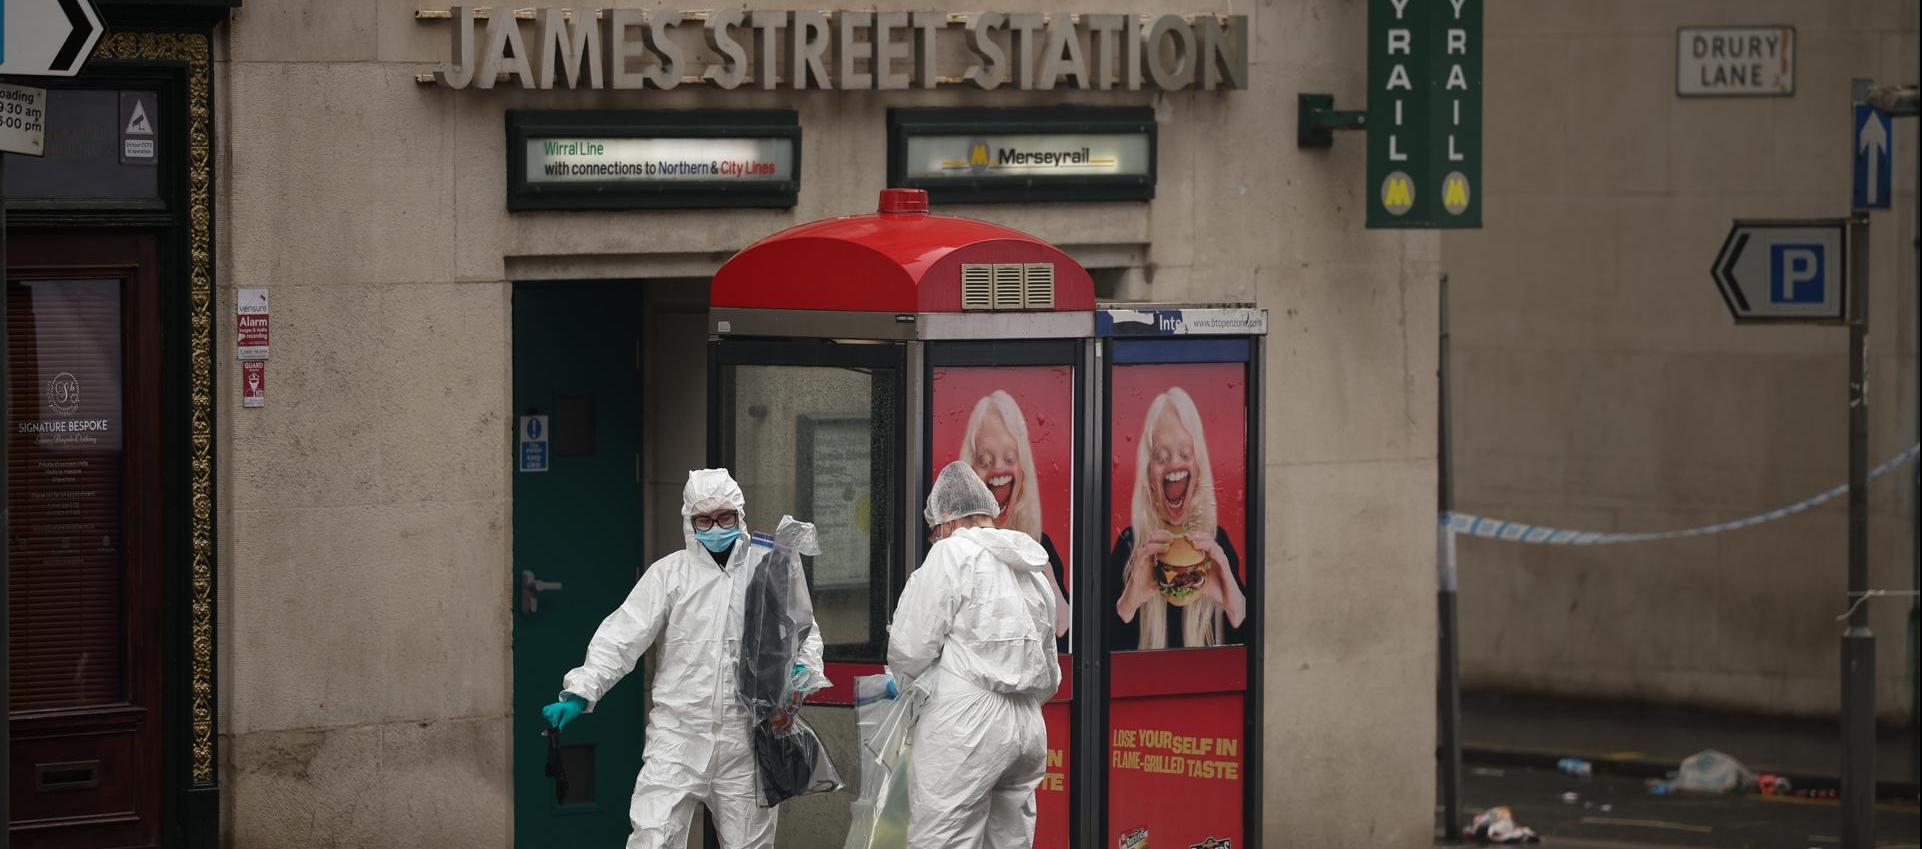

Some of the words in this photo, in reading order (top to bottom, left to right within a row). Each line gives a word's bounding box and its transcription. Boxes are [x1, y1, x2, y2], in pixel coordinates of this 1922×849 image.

[433, 7, 684, 90] JAMES
[704, 8, 948, 90] STREET
[962, 11, 1249, 91] STATION
[1693, 35, 1778, 59] DRURY
[1701, 63, 1763, 87] LANE
[25, 108, 42, 118] am
[25, 122, 42, 132] pm
[544, 141, 578, 156] Wirral
[580, 141, 604, 156] Line
[998, 148, 1090, 167] Merseyrail
[544, 161, 569, 176] with
[571, 162, 643, 176] connections
[645, 163, 656, 176] to
[658, 161, 709, 176] Northern
[711, 163, 719, 176] &
[720, 160, 743, 178] City
[745, 160, 776, 176] Lines
[1783, 249, 1817, 299] P
[240, 316, 267, 327] Alarm
[18, 421, 66, 433] SIGNATURE
[69, 420, 108, 432] BESPOKE
[1113, 729, 1136, 748] LOSE
[1138, 729, 1213, 755] YOURSELF
[1215, 738, 1238, 756] IN
[1112, 750, 1185, 774] FLAME-GRILLED
[1186, 759, 1239, 779] TASTE
